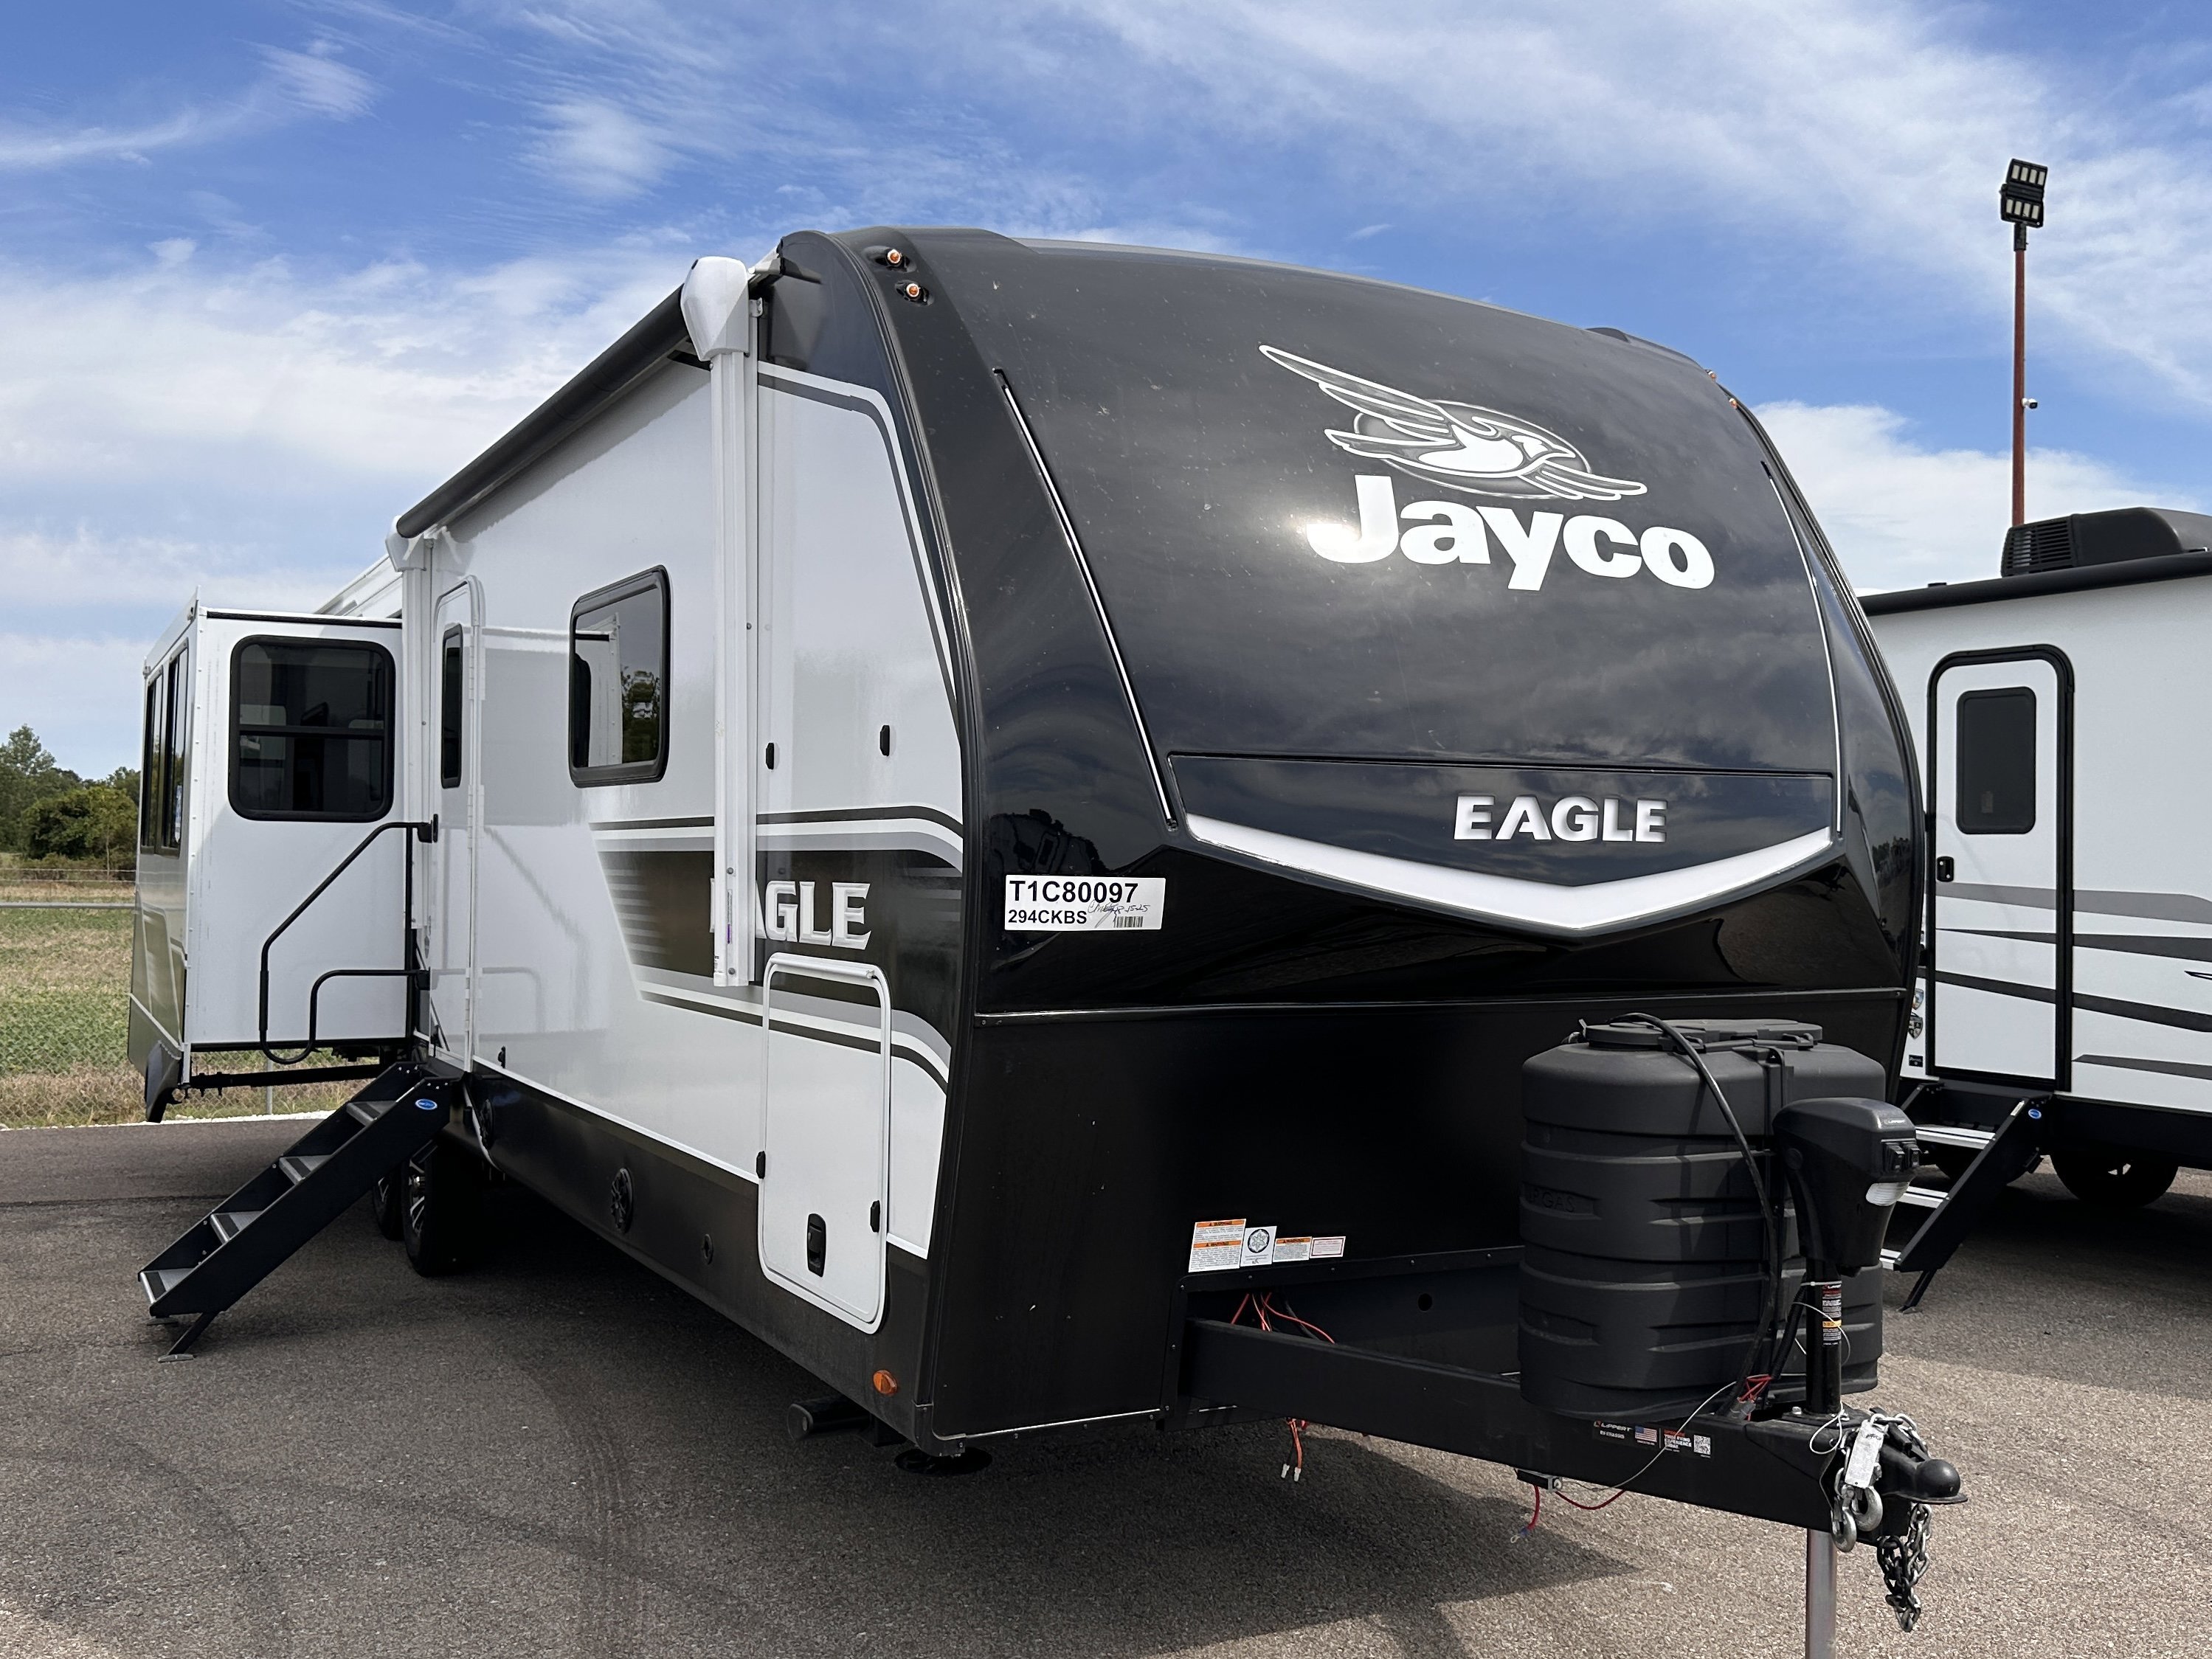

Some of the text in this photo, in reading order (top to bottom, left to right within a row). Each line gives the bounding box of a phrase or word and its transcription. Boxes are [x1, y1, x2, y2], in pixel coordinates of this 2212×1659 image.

[1305, 474, 1715, 591] Jayco
[1454, 795, 1667, 842] EAGLE
[1009, 880, 1138, 904] T1C80097
[709, 877, 872, 950] GLE
[1008, 909, 1088, 924] 294CKBS
[1542, 1191, 1575, 1213] GAS
